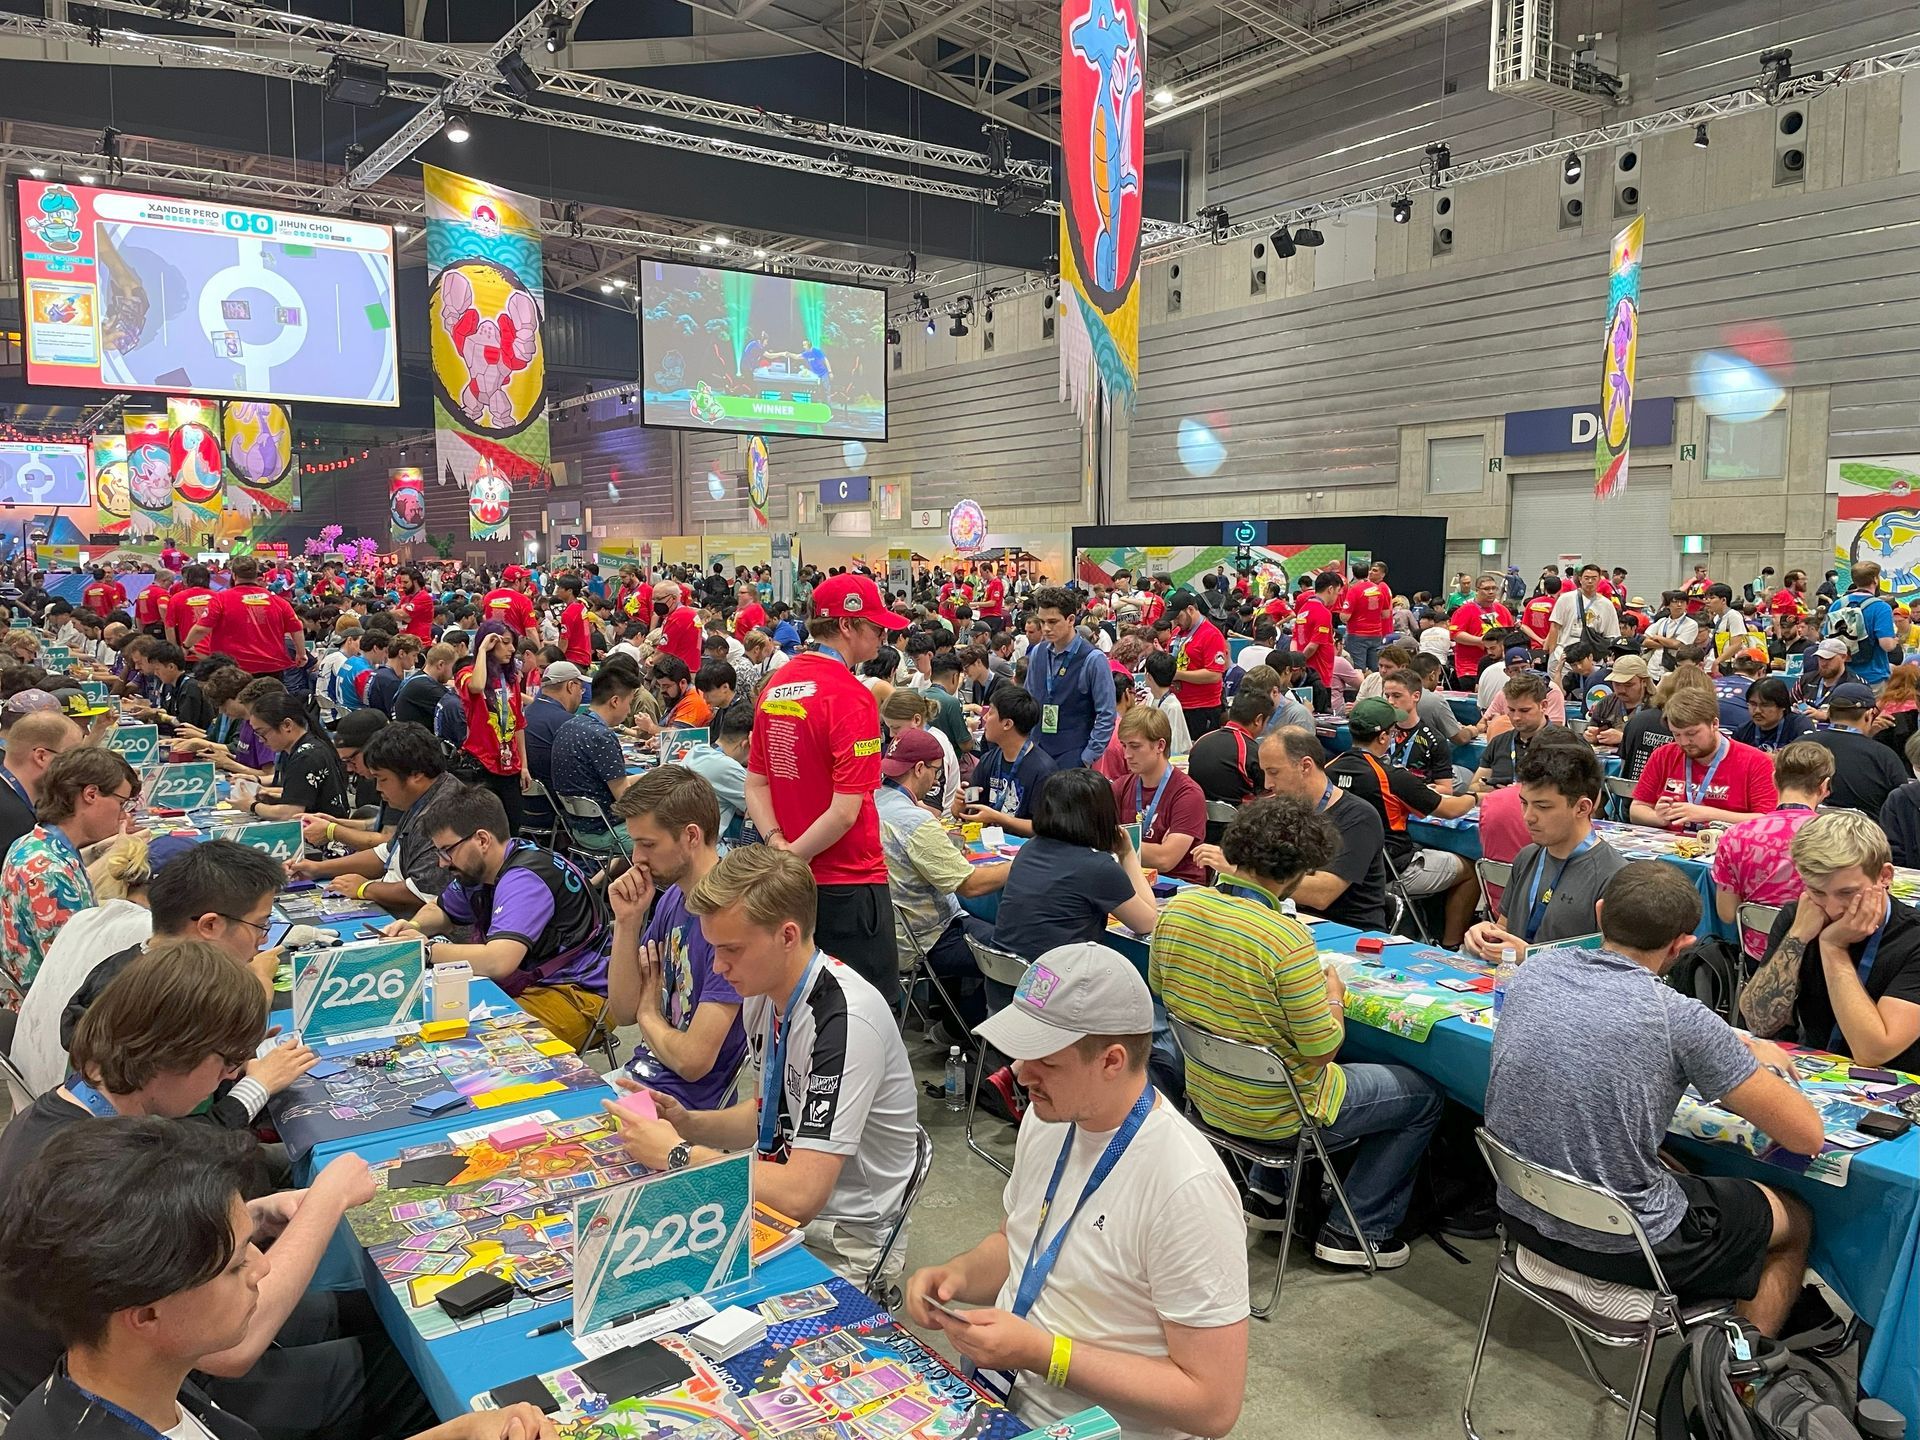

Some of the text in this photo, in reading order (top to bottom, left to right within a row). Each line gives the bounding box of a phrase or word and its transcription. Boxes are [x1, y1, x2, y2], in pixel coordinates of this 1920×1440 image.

[149, 203, 219, 219] XANDER PERO
[230, 214, 243, 229] 0
[256, 217, 269, 232] 0
[279, 220, 333, 233] JIHUN CHOI
[752, 402, 794, 416] WINNER
[1572, 412, 1598, 444] D
[839, 481, 848, 499] C
[774, 685, 806, 699] STAFF
[111, 738, 150, 752] 220
[1643, 731, 1673, 743] WINTER
[158, 777, 206, 797] 222
[321, 969, 405, 1009] 226
[613, 1203, 727, 1280] 228
[884, 1332, 982, 1412] YOKOHAMA
